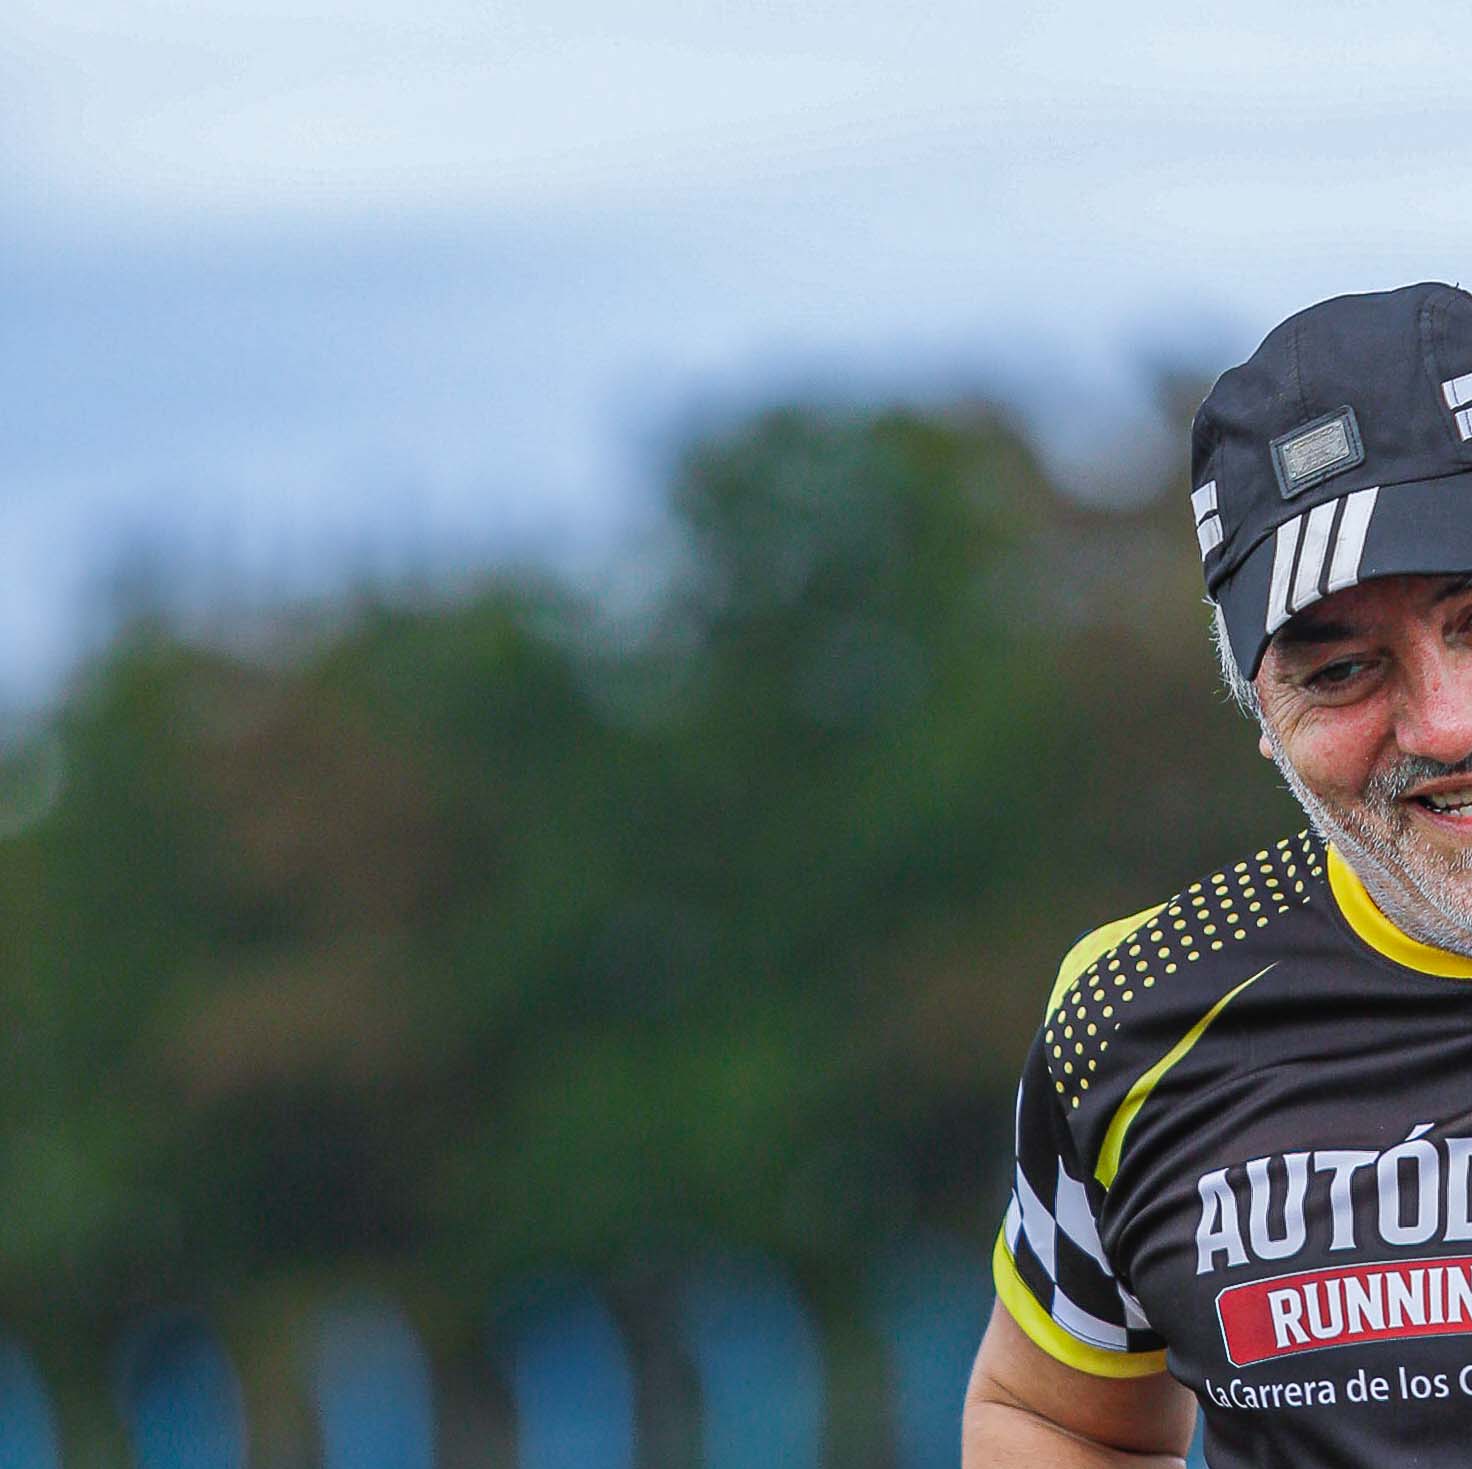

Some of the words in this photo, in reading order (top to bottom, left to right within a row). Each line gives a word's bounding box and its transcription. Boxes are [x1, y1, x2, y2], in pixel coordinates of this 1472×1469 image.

[1205, 1379, 1232, 1408] La
[1229, 1378, 1336, 1409] Carrera
[1346, 1369, 1390, 1402] de
[1399, 1366, 1450, 1400] los
